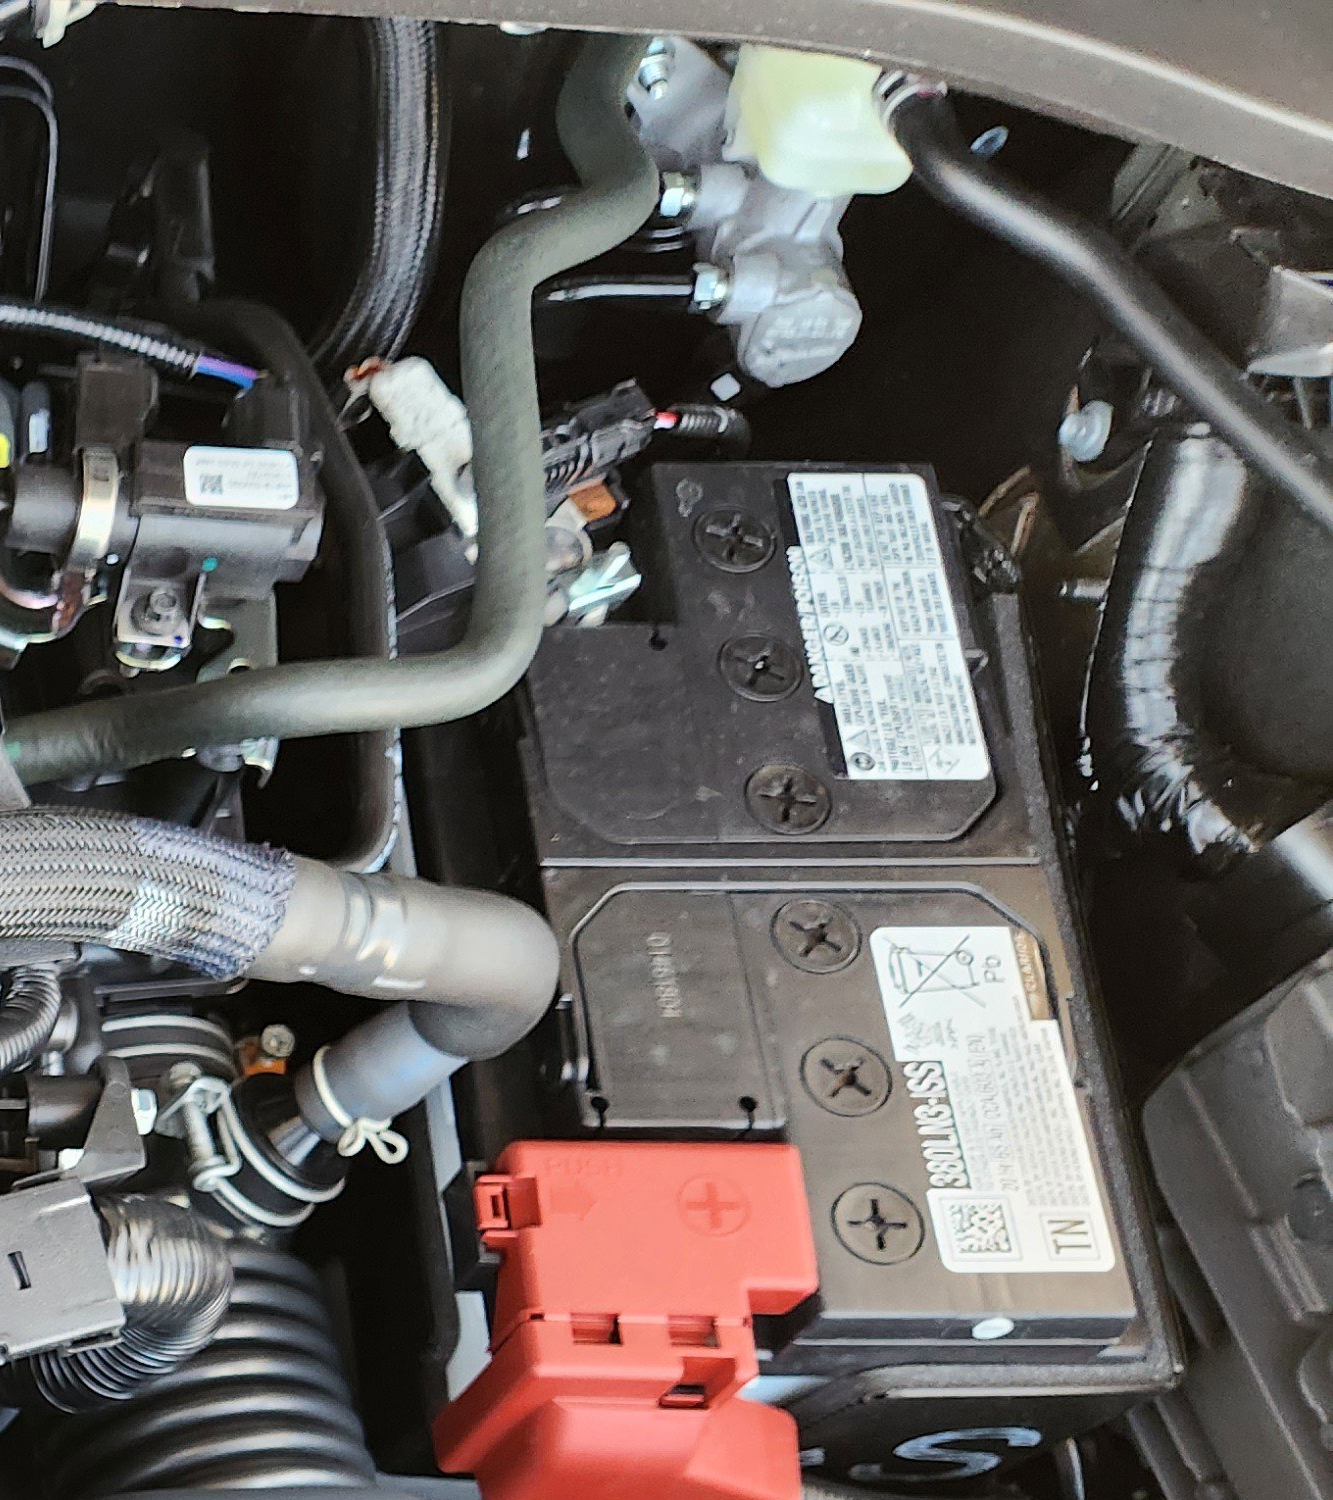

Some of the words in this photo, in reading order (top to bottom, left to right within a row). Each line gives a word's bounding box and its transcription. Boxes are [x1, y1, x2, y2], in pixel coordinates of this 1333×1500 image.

[983, 954, 1005, 985] Pb
[903, 1061, 967, 1188] 380LN3-ISS
[1048, 1218, 1092, 1255] TN
